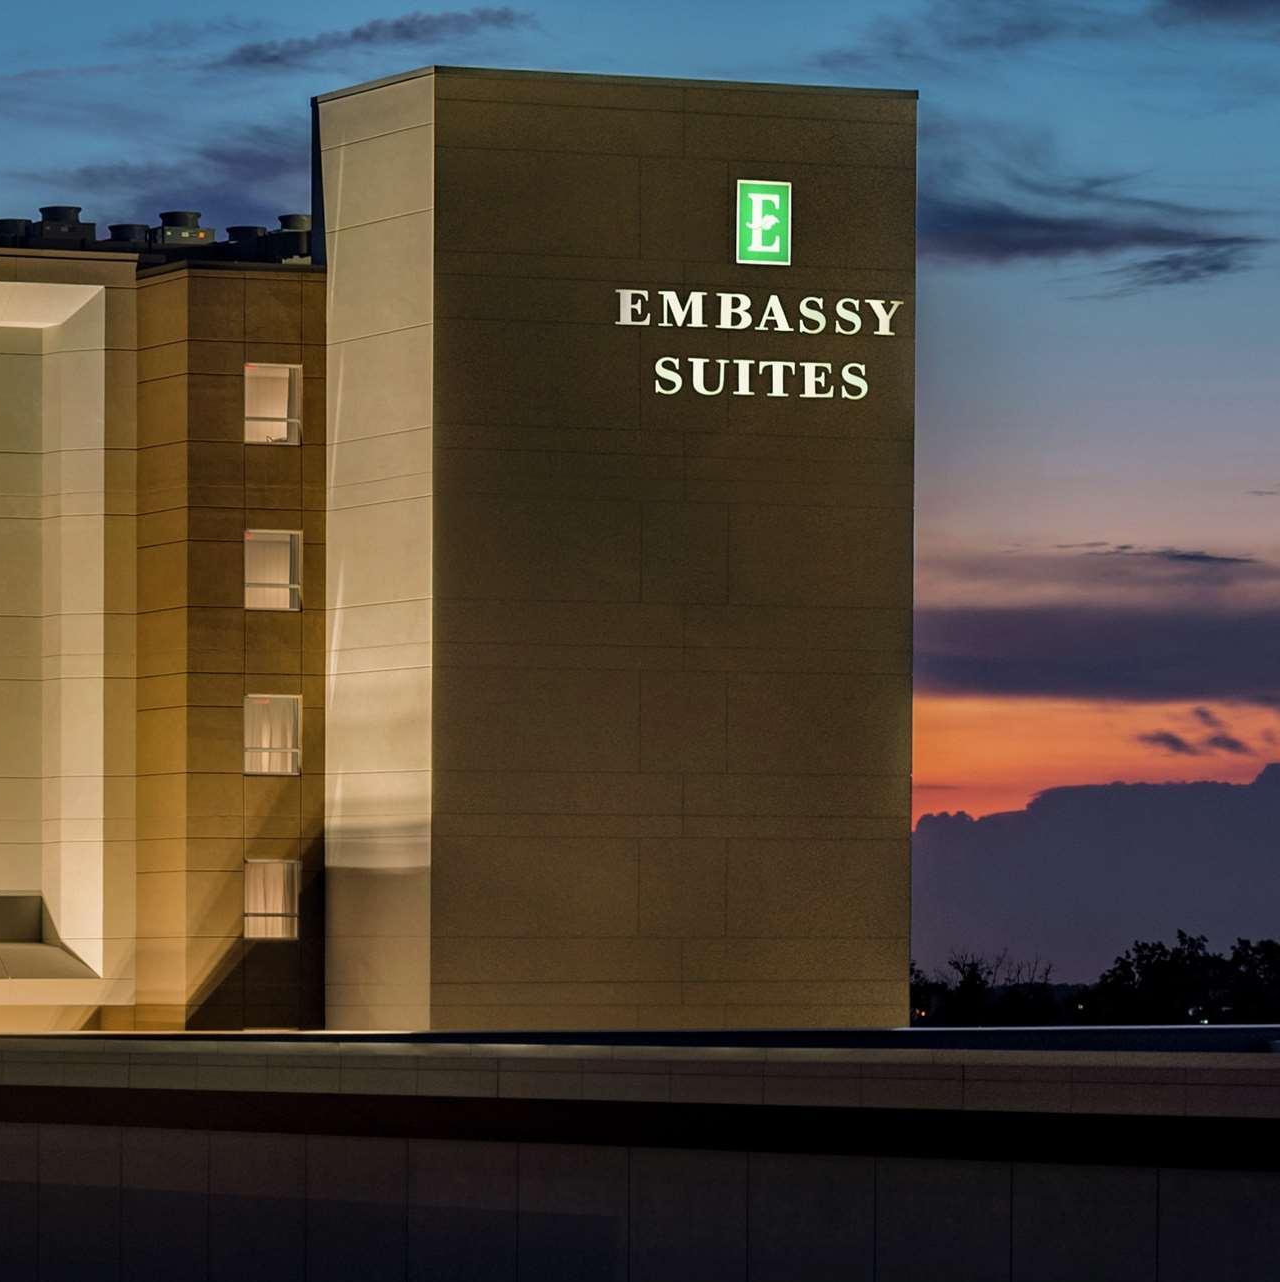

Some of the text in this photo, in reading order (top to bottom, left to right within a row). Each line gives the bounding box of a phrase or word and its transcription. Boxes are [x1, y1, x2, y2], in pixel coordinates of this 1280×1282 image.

[746, 192, 781, 254] E
[615, 289, 904, 336] EMBASSY
[655, 357, 868, 400] SUITES
